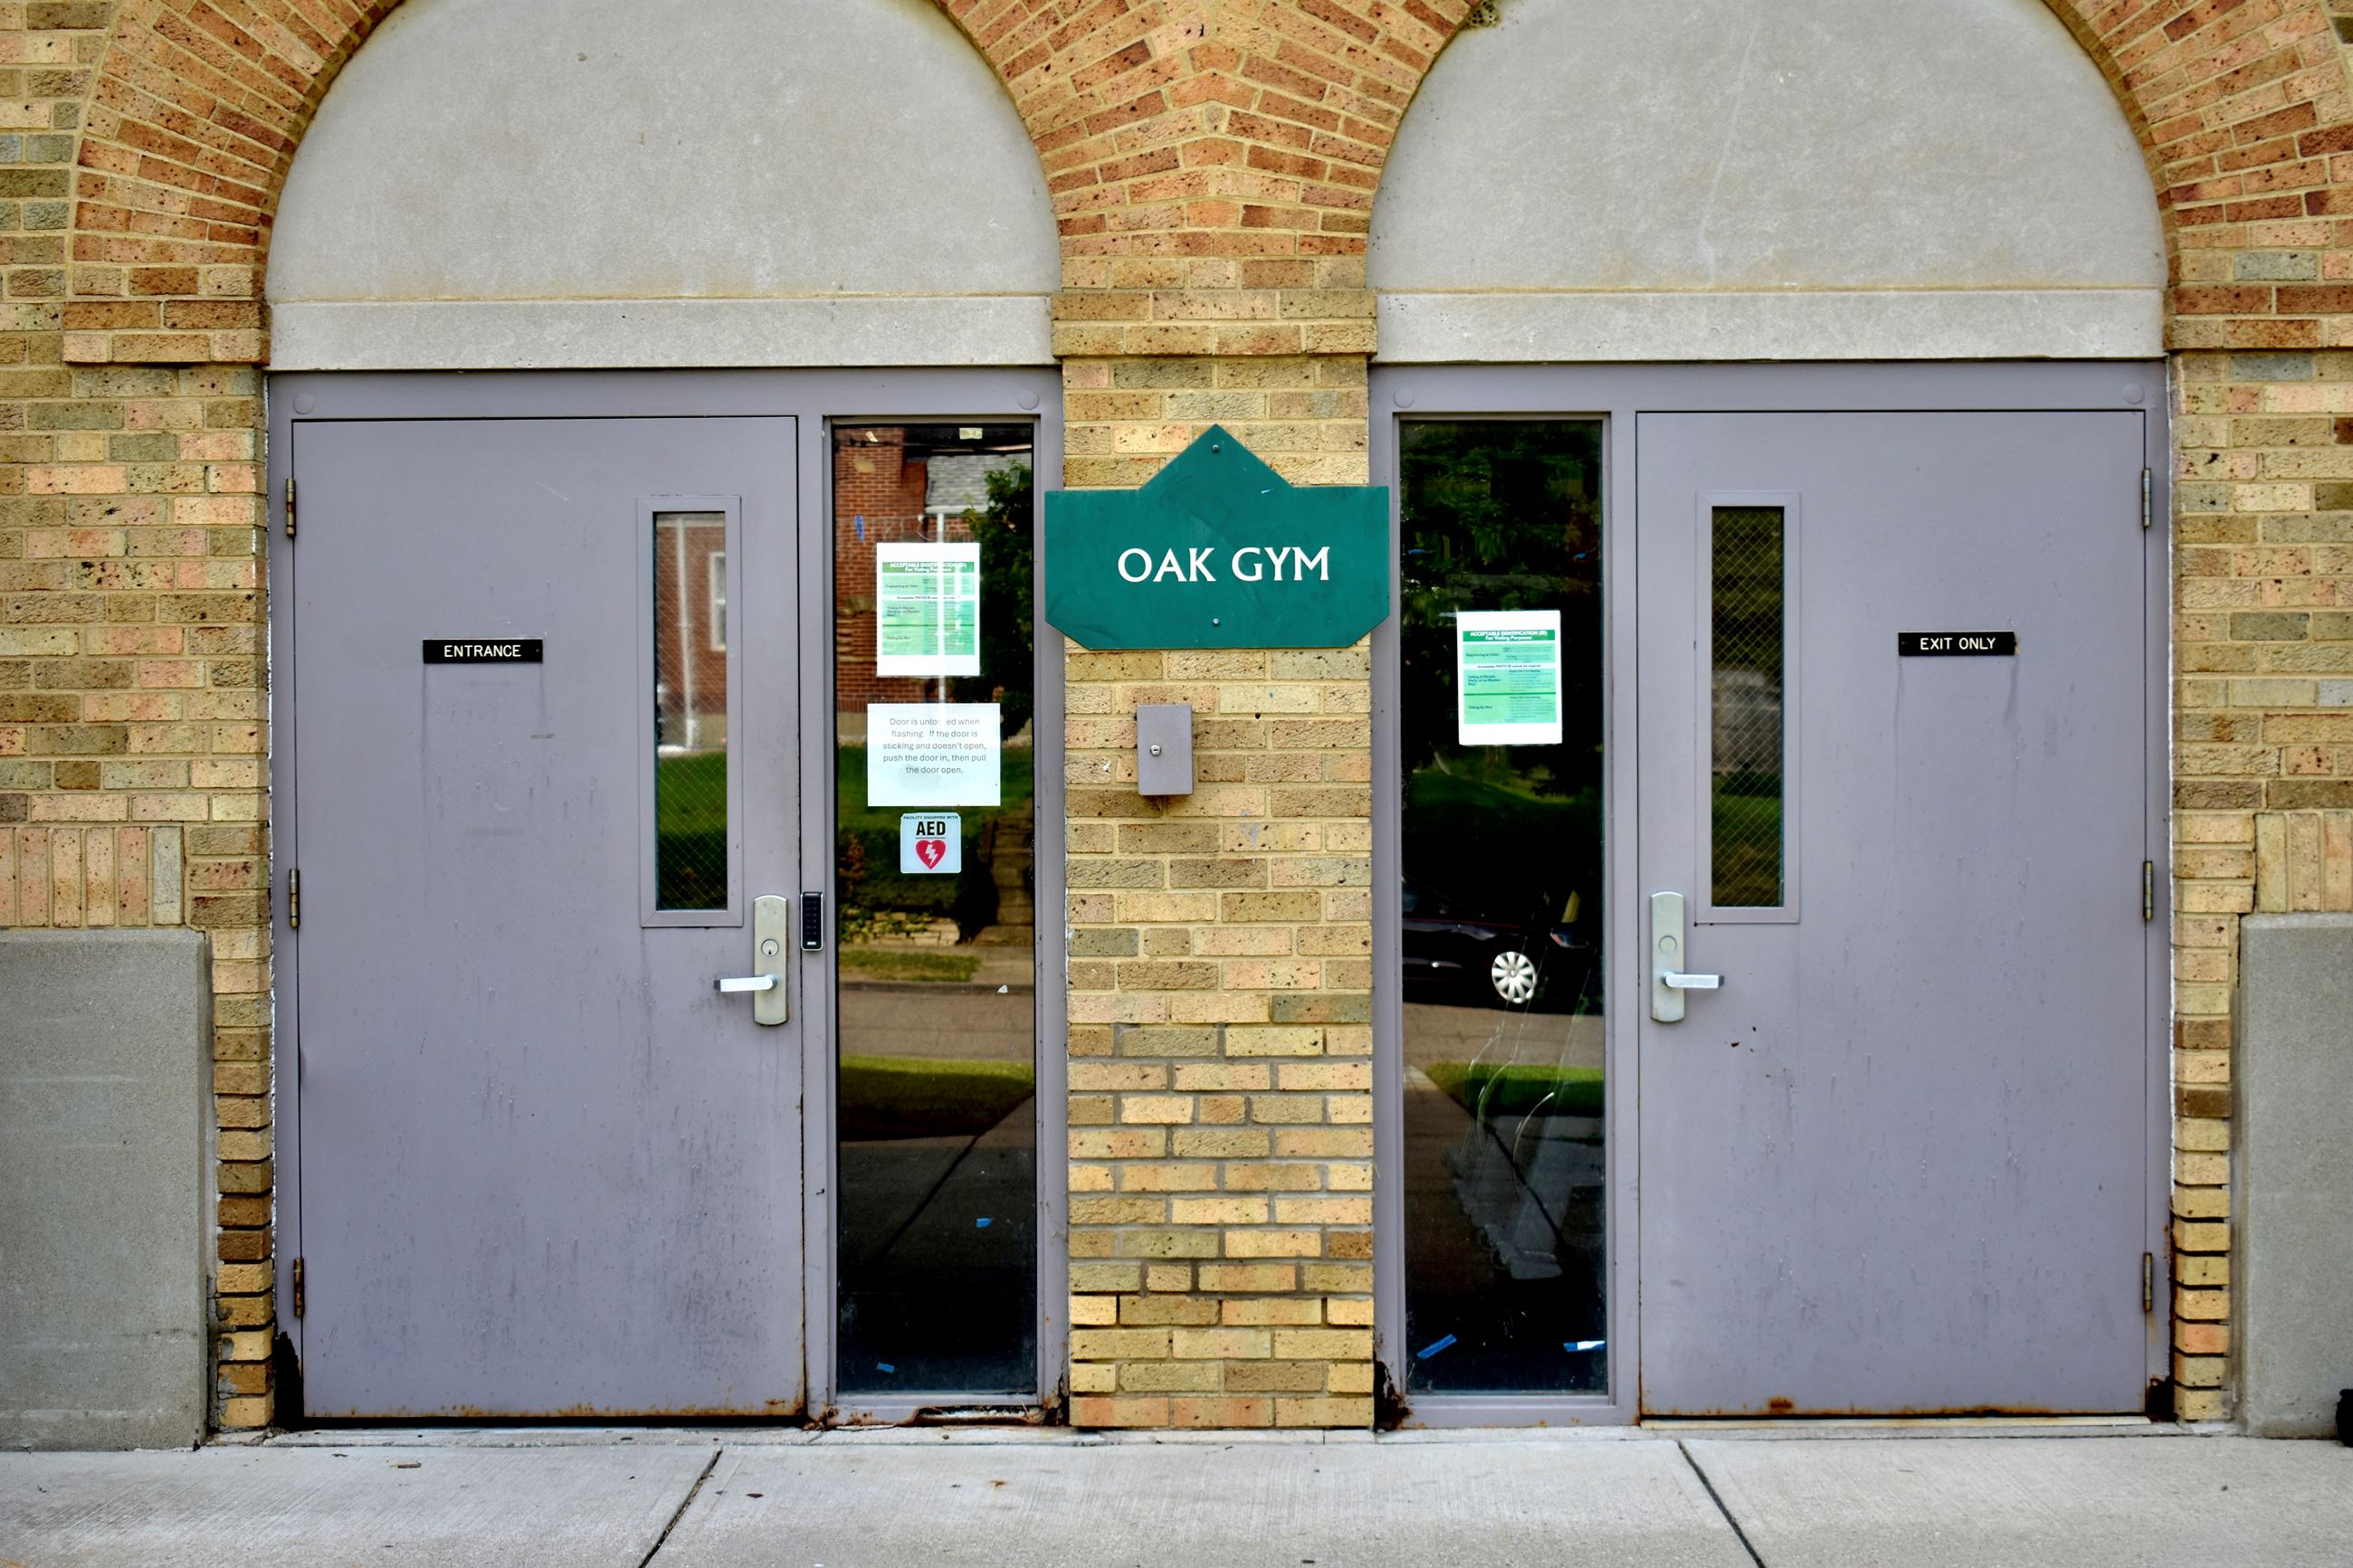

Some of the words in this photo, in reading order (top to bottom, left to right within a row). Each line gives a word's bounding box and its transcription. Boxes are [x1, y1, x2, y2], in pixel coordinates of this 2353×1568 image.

[1118, 548, 1216, 583] OAK
[1232, 546, 1330, 582] GYM
[1920, 638, 1953, 650] EXIT
[1958, 637, 1996, 650] ONLY
[444, 645, 521, 657] ENTRANCE
[883, 743, 914, 751] sticking
[883, 755, 902, 763] push
[971, 755, 986, 763] pull
[916, 822, 946, 835] AED
